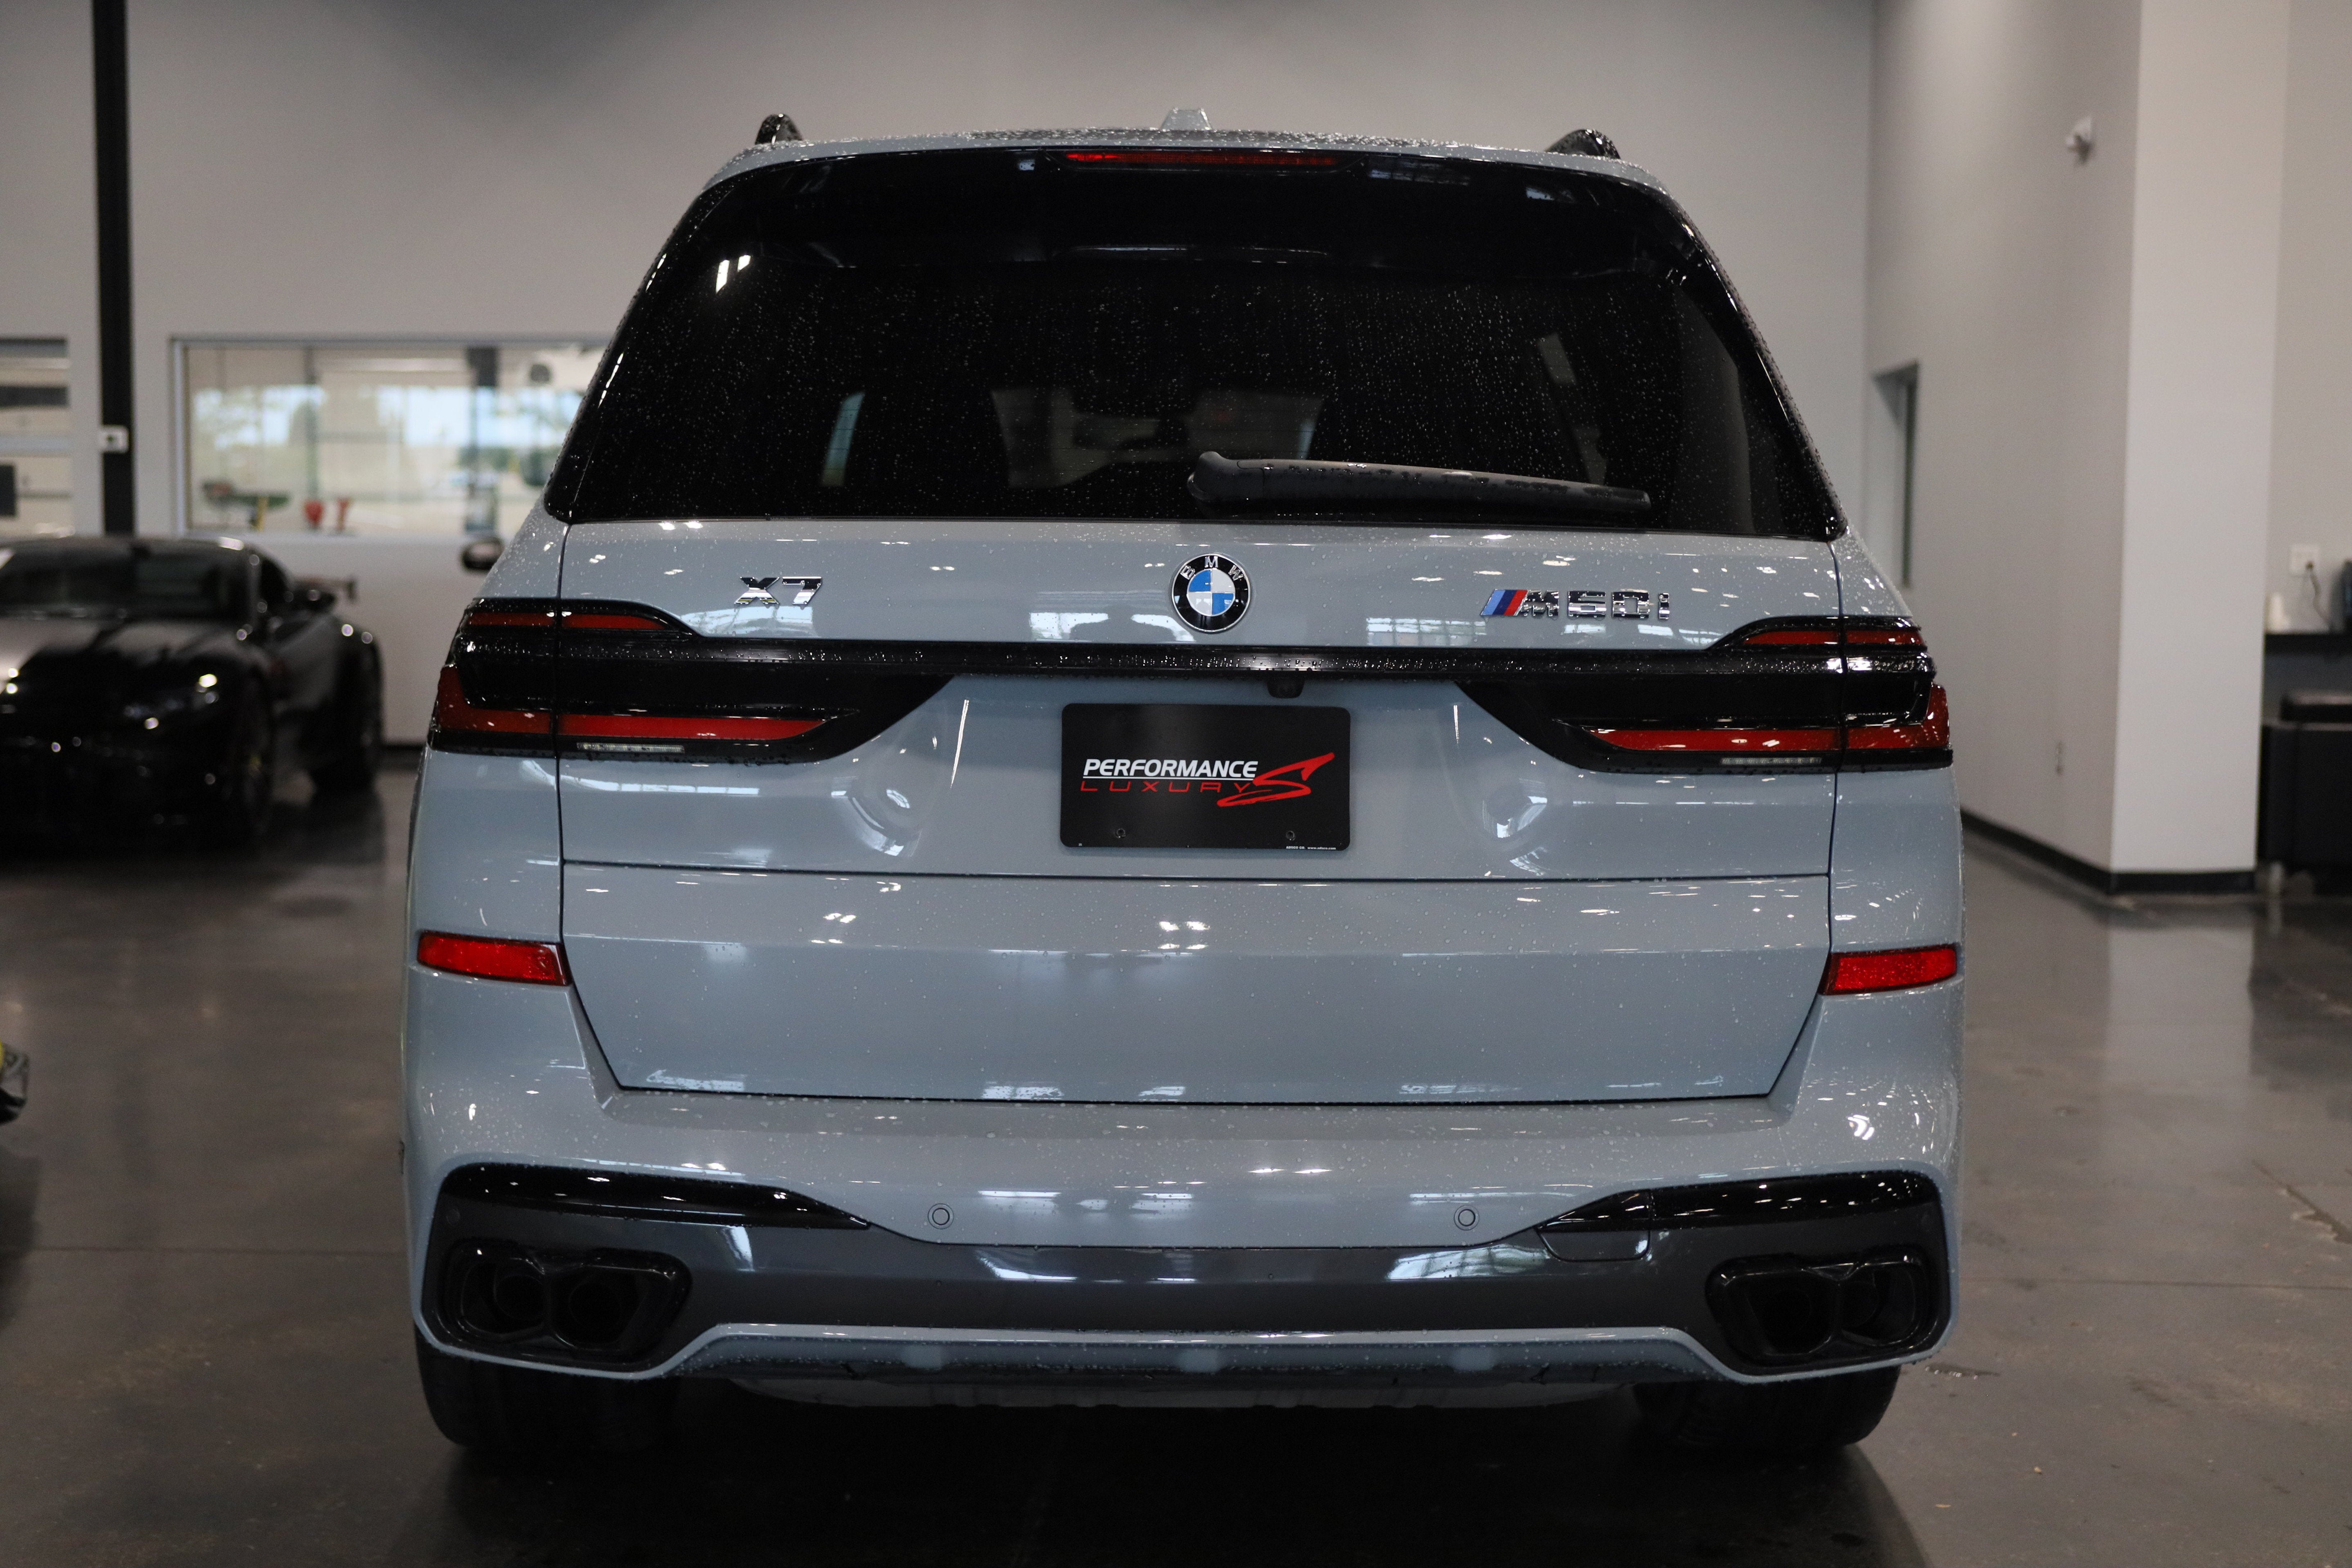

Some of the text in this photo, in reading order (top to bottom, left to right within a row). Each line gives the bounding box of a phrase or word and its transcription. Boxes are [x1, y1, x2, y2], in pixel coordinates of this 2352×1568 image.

[1180, 556, 1244, 581] BMW
[734, 576, 822, 604] X7
[1083, 758, 1258, 778] PERFORMANCE
[1080, 781, 1250, 793] LUXURY
